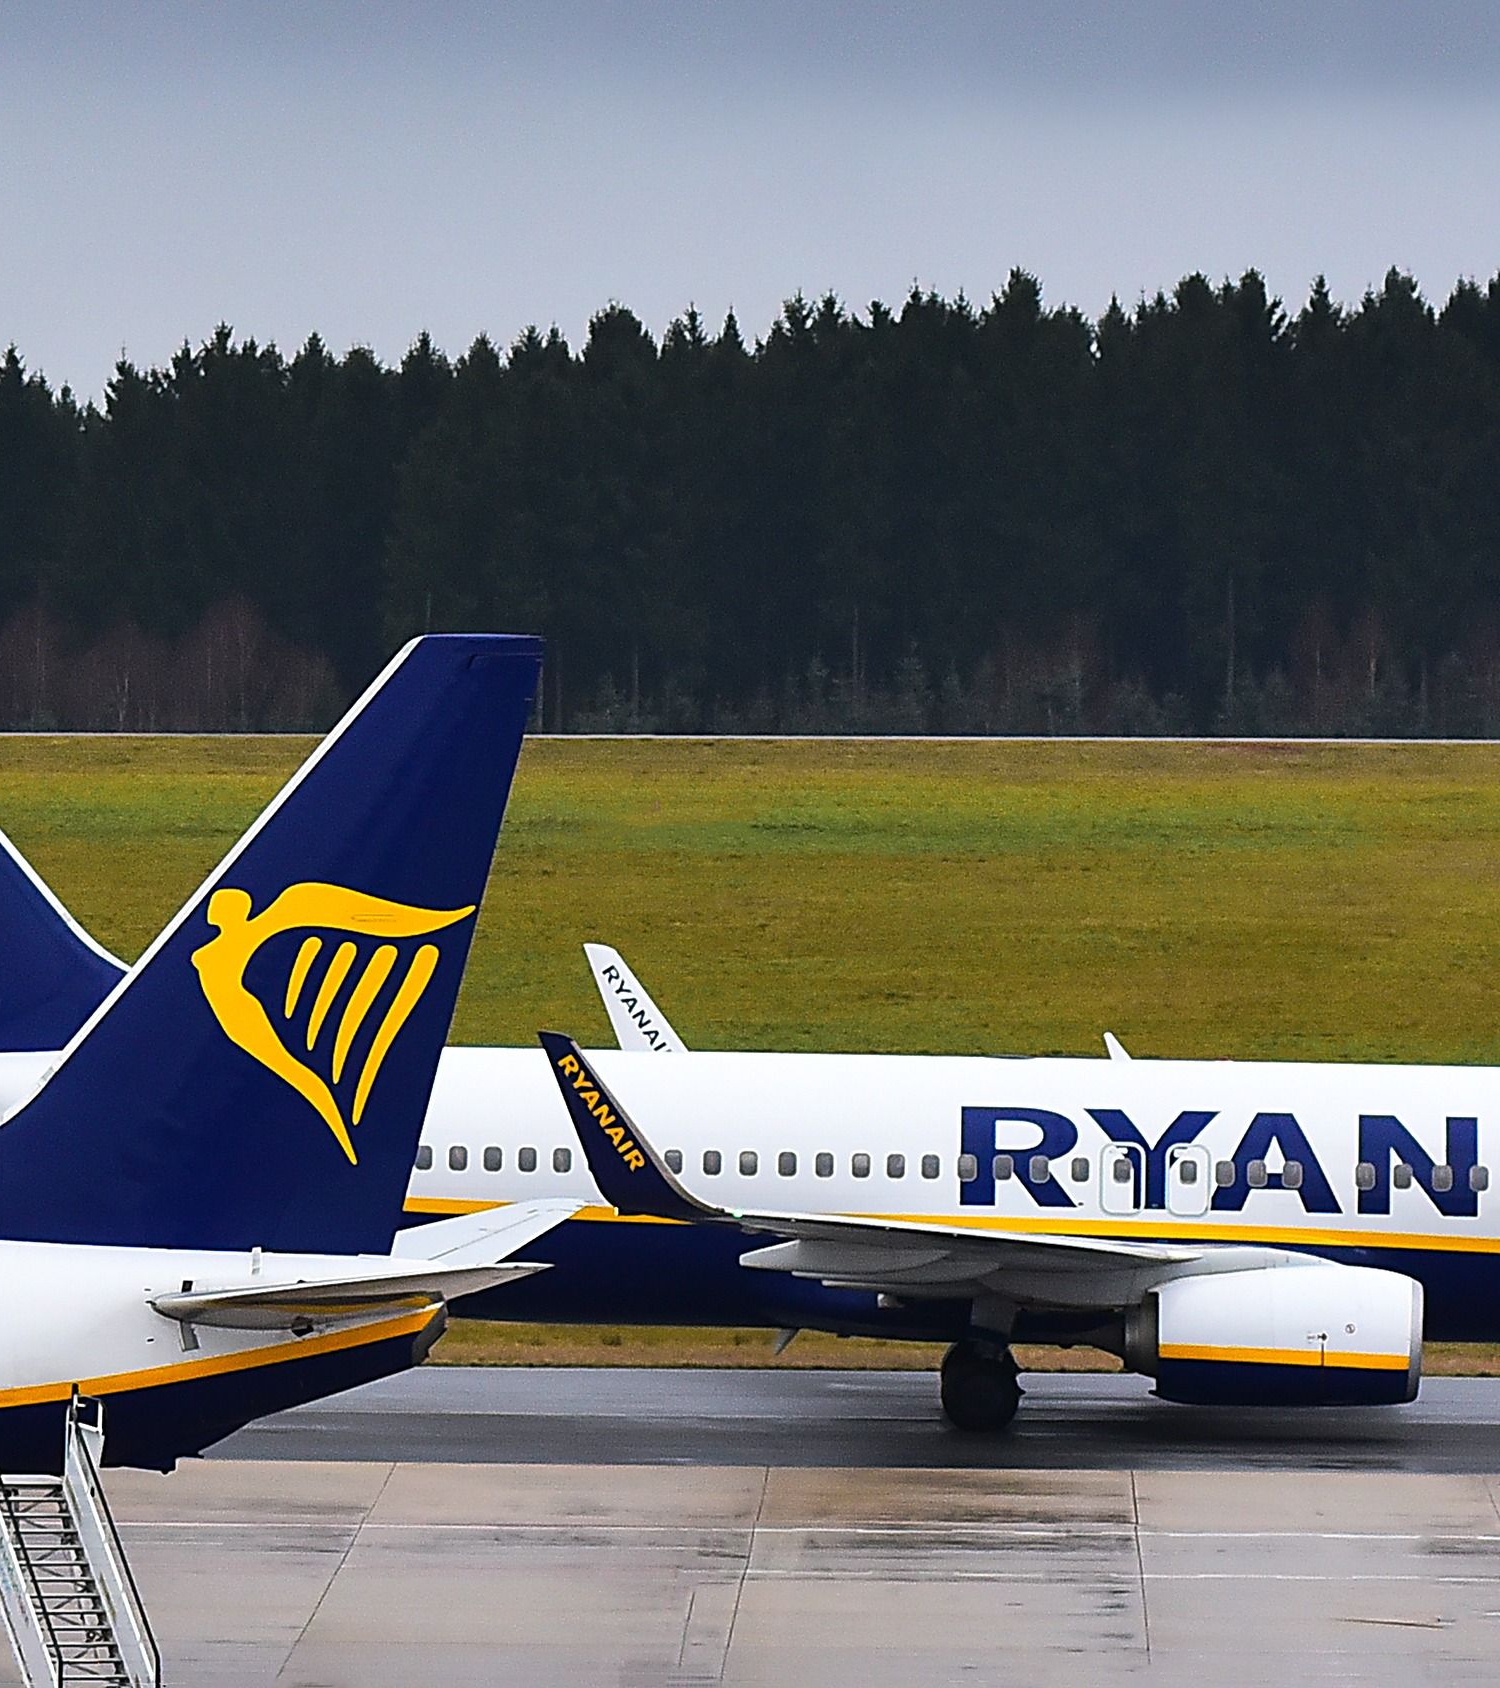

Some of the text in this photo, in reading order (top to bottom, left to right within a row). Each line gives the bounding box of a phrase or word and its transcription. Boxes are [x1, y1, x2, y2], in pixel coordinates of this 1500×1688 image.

[602, 965, 671, 1052] RYANAI
[557, 1054, 645, 1172] RYANAIR
[959, 1106, 1479, 1217] RYAN
